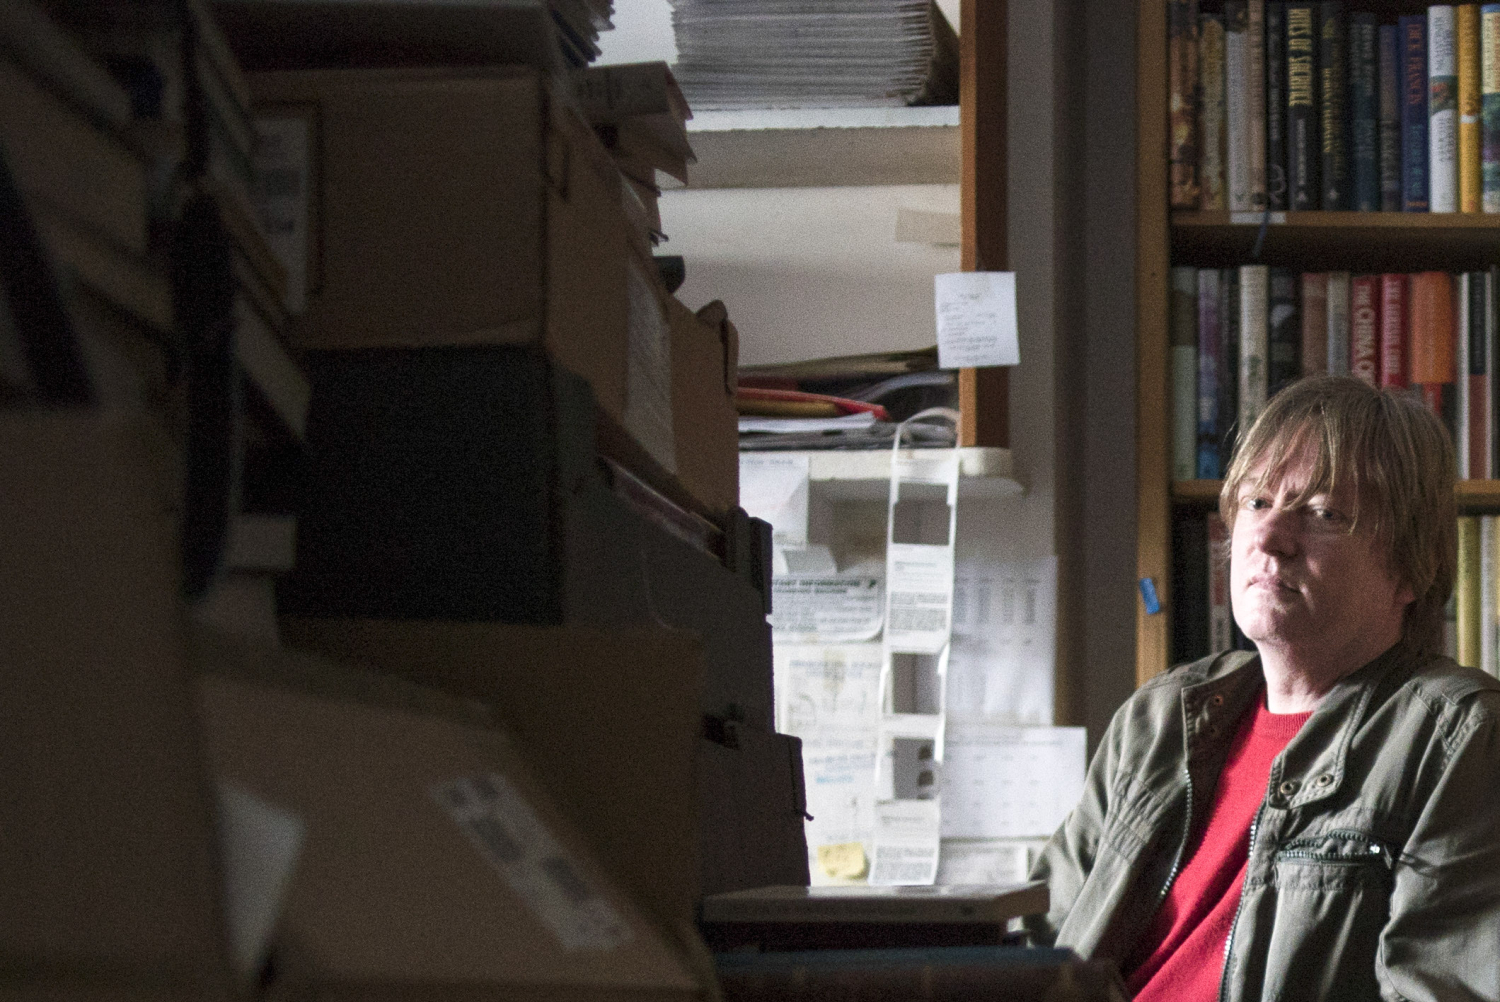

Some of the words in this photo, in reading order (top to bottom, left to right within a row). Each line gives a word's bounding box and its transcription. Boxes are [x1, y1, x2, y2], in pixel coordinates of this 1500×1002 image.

[1289, 8, 1313, 36] RITES
[1407, 23, 1424, 52] DICK
[1289, 38, 1313, 52] OF
[1289, 55, 1313, 107] SACRIFICE
[1407, 56, 1424, 106] FRANCIS
[1322, 102, 1333, 154] CHAPMAN
[1357, 284, 1372, 306] THE
[1354, 307, 1376, 358] CHINA
